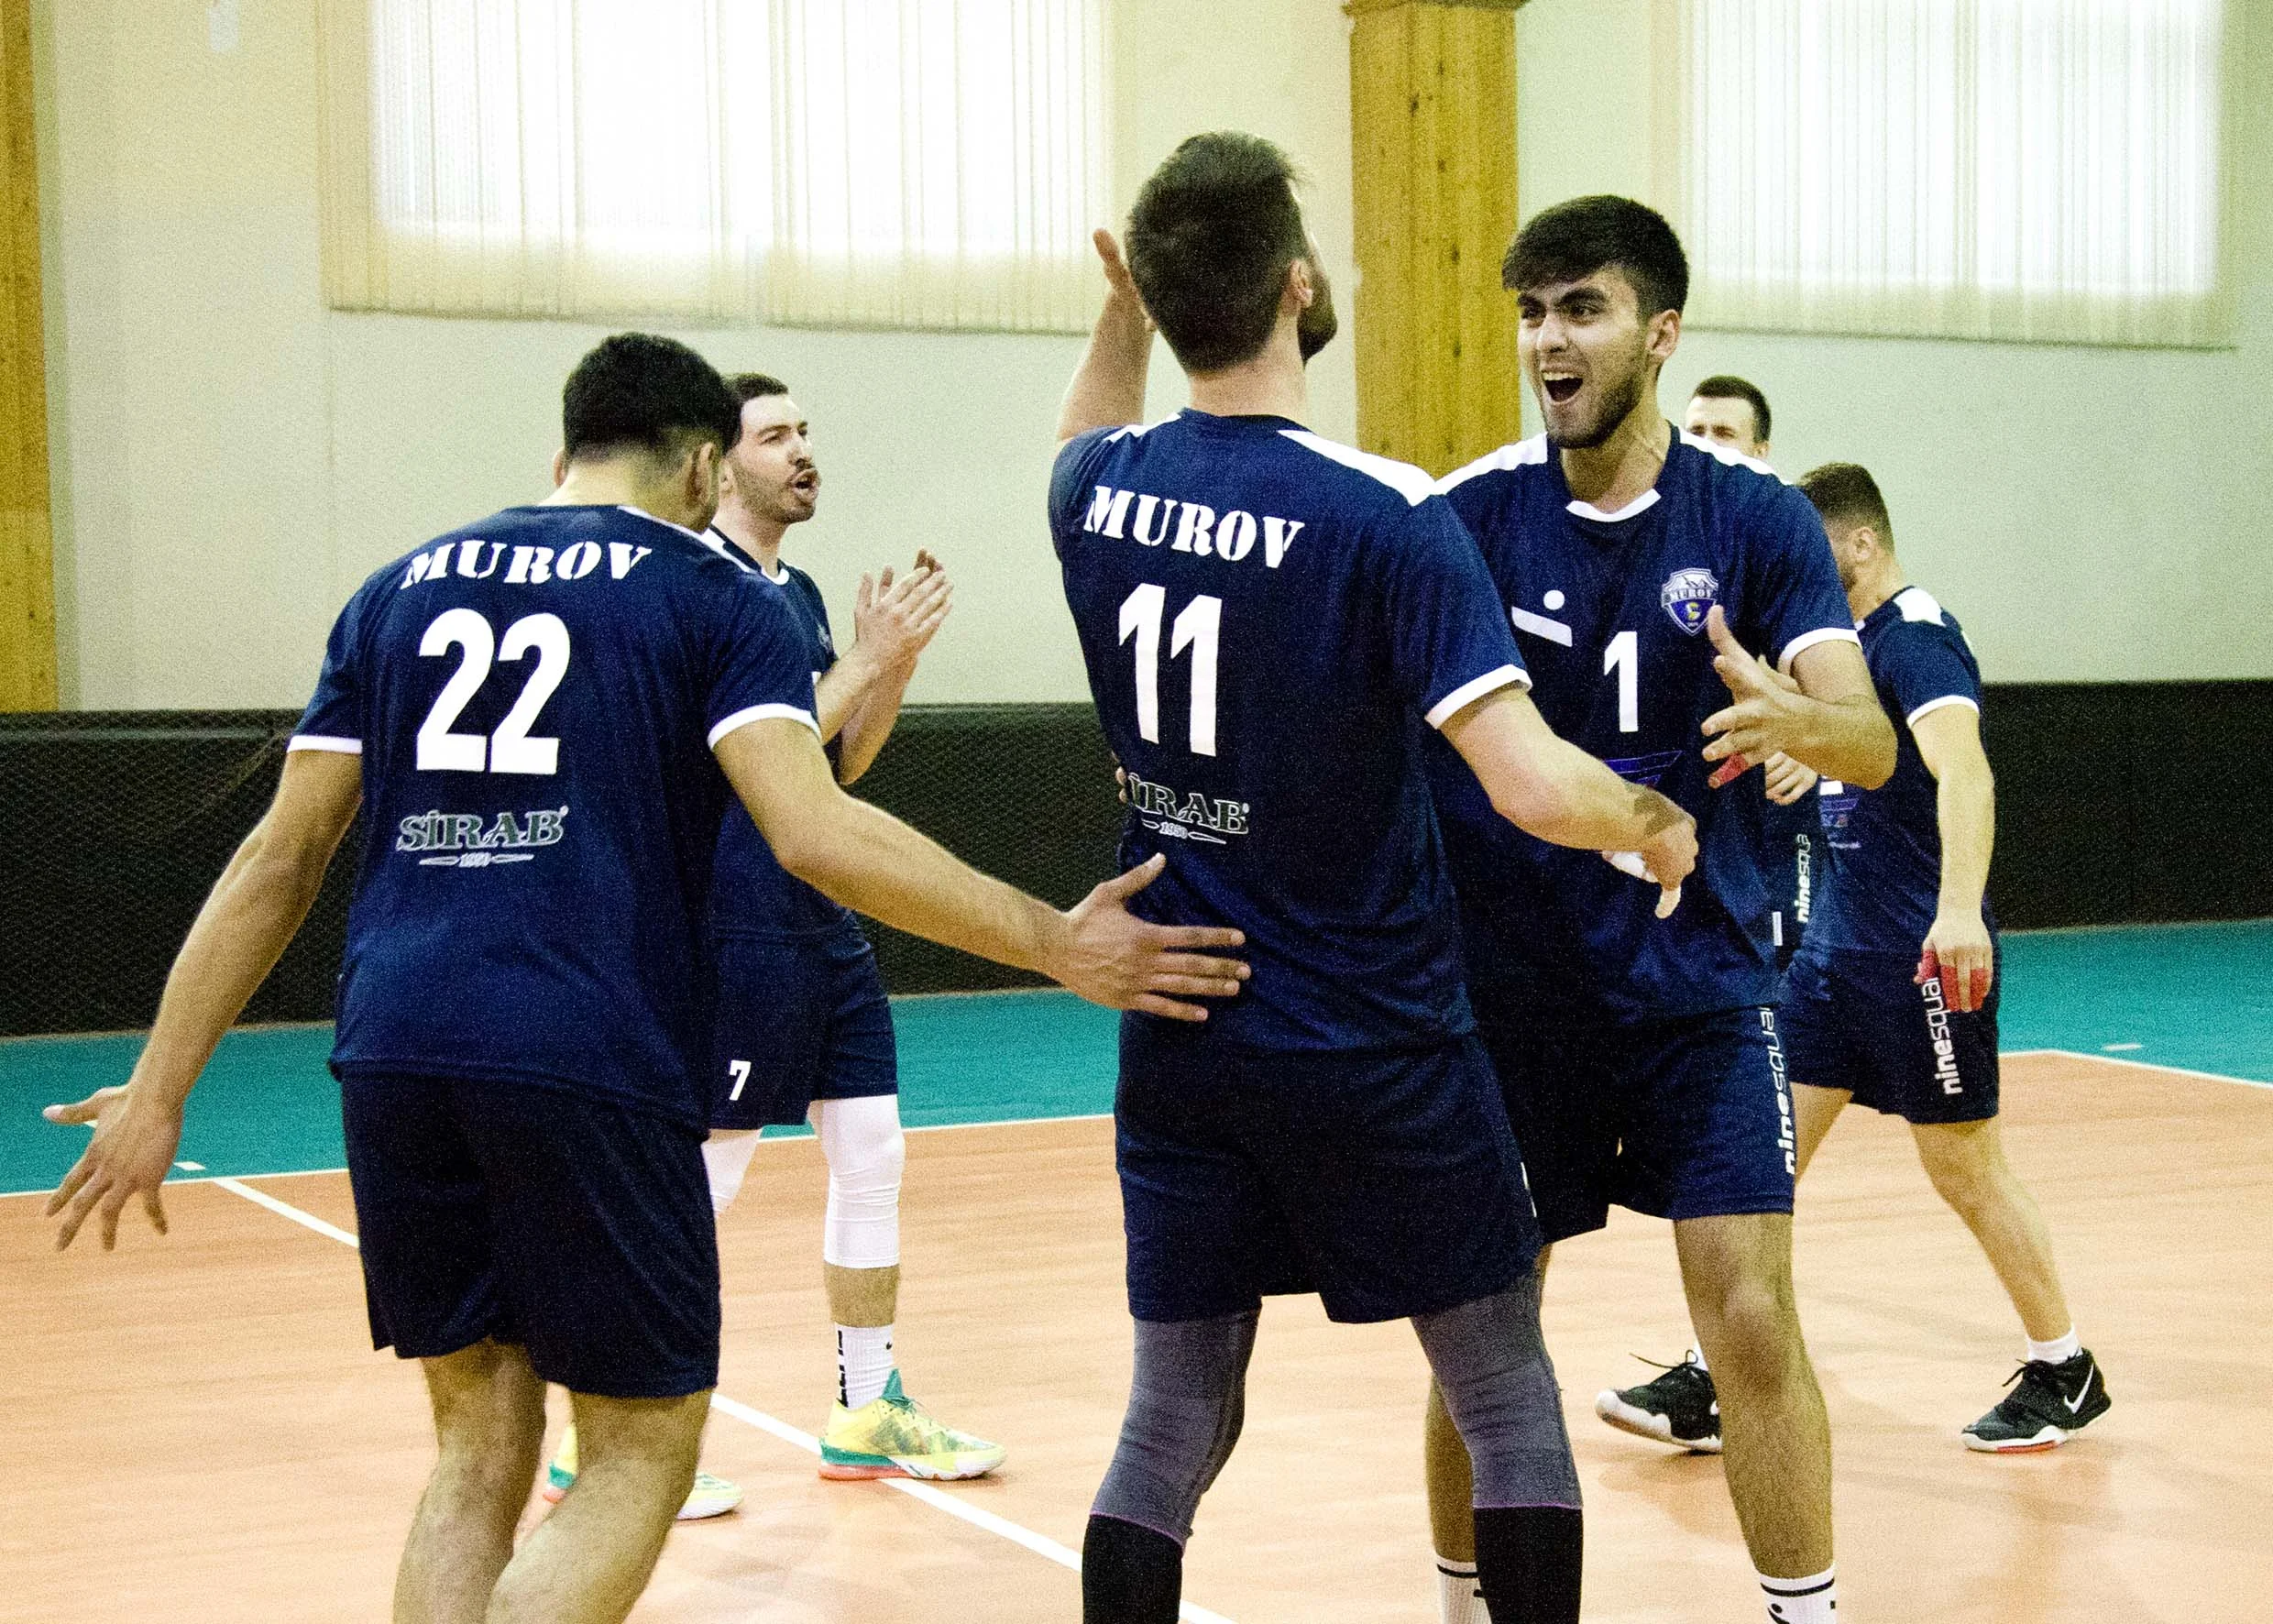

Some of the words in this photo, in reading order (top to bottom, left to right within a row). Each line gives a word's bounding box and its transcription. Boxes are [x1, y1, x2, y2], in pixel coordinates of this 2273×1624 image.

[1084, 485, 1305, 569] MUROV
[400, 539, 653, 590] MUROV
[416, 608, 571, 775] 22
[1118, 582, 1223, 757] 11
[1603, 631, 1639, 732] 1
[1128, 772, 1249, 835] İRAB
[1159, 821, 1188, 839] 1950
[729, 1059, 752, 1102] 7
